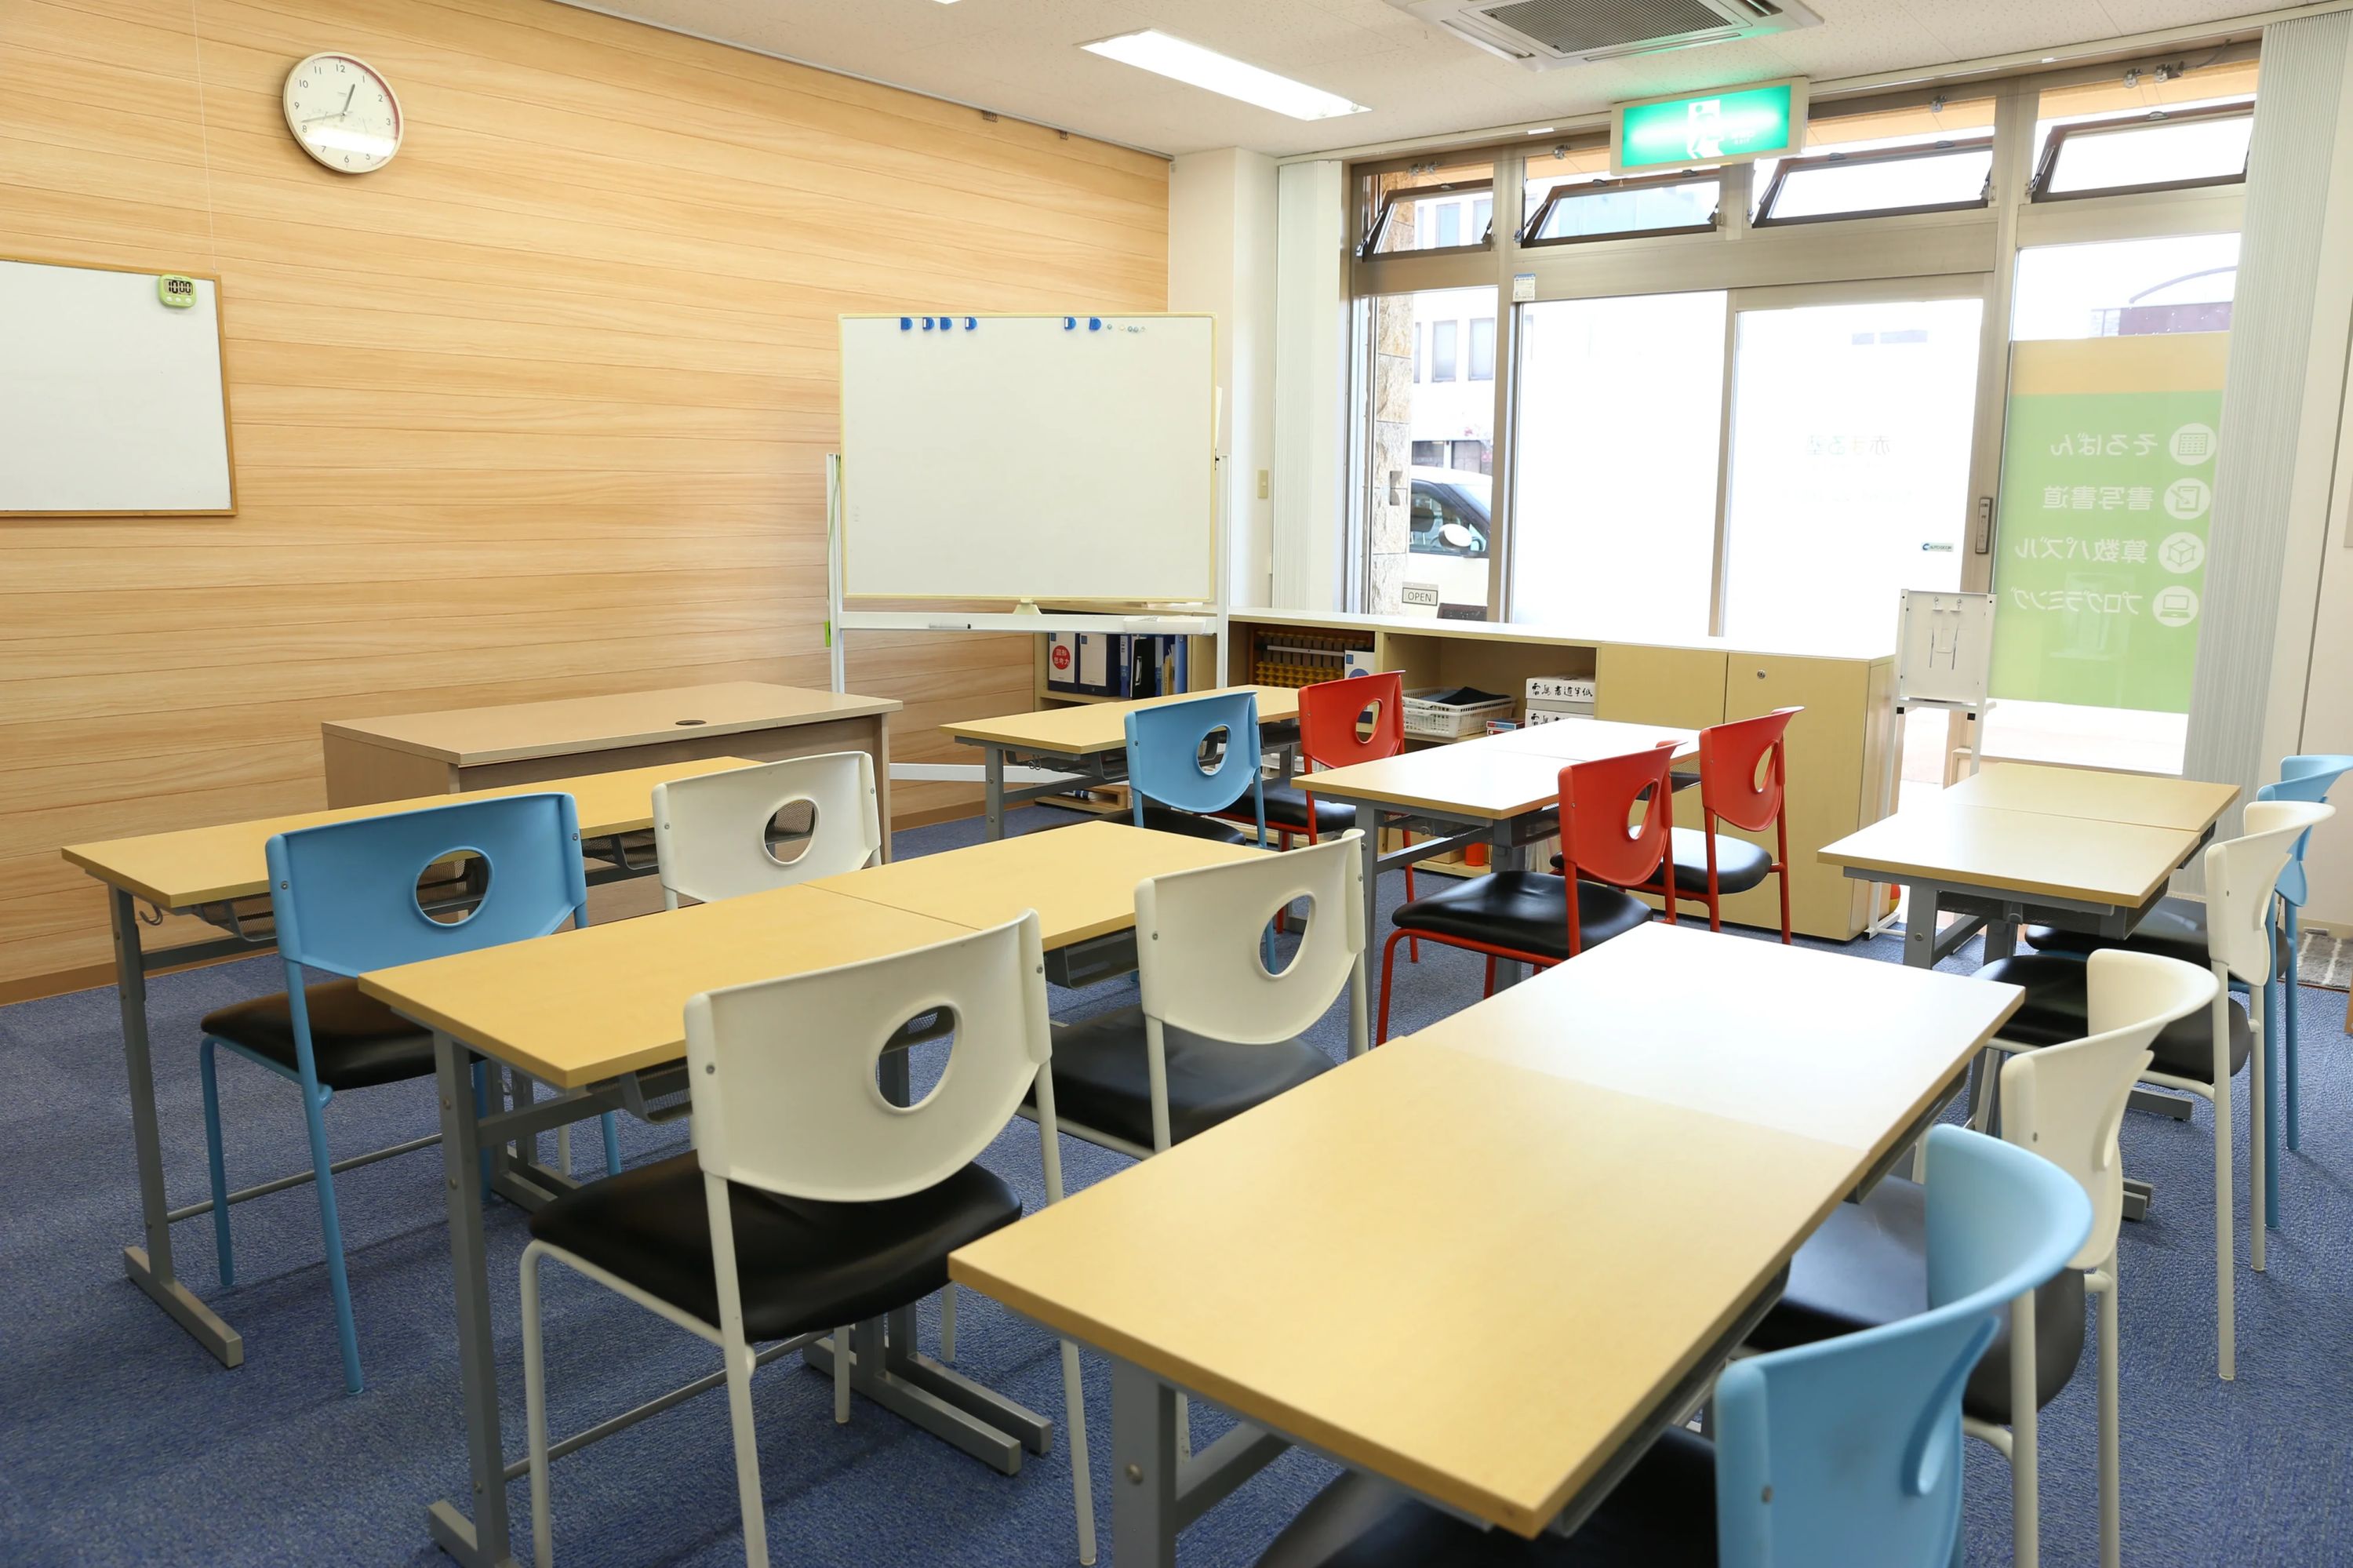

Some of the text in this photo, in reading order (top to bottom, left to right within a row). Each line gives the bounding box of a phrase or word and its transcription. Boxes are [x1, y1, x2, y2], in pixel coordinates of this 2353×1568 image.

[314, 66, 322, 75] 11
[336, 64, 346, 73] 12
[299, 79, 308, 89] 10
[377, 94, 383, 103] 2
[294, 101, 300, 110] 9
[385, 118, 391, 126] 3
[302, 125, 307, 133] 8
[344, 155, 350, 163] 6
[1408, 591, 1431, 602] OPEN
